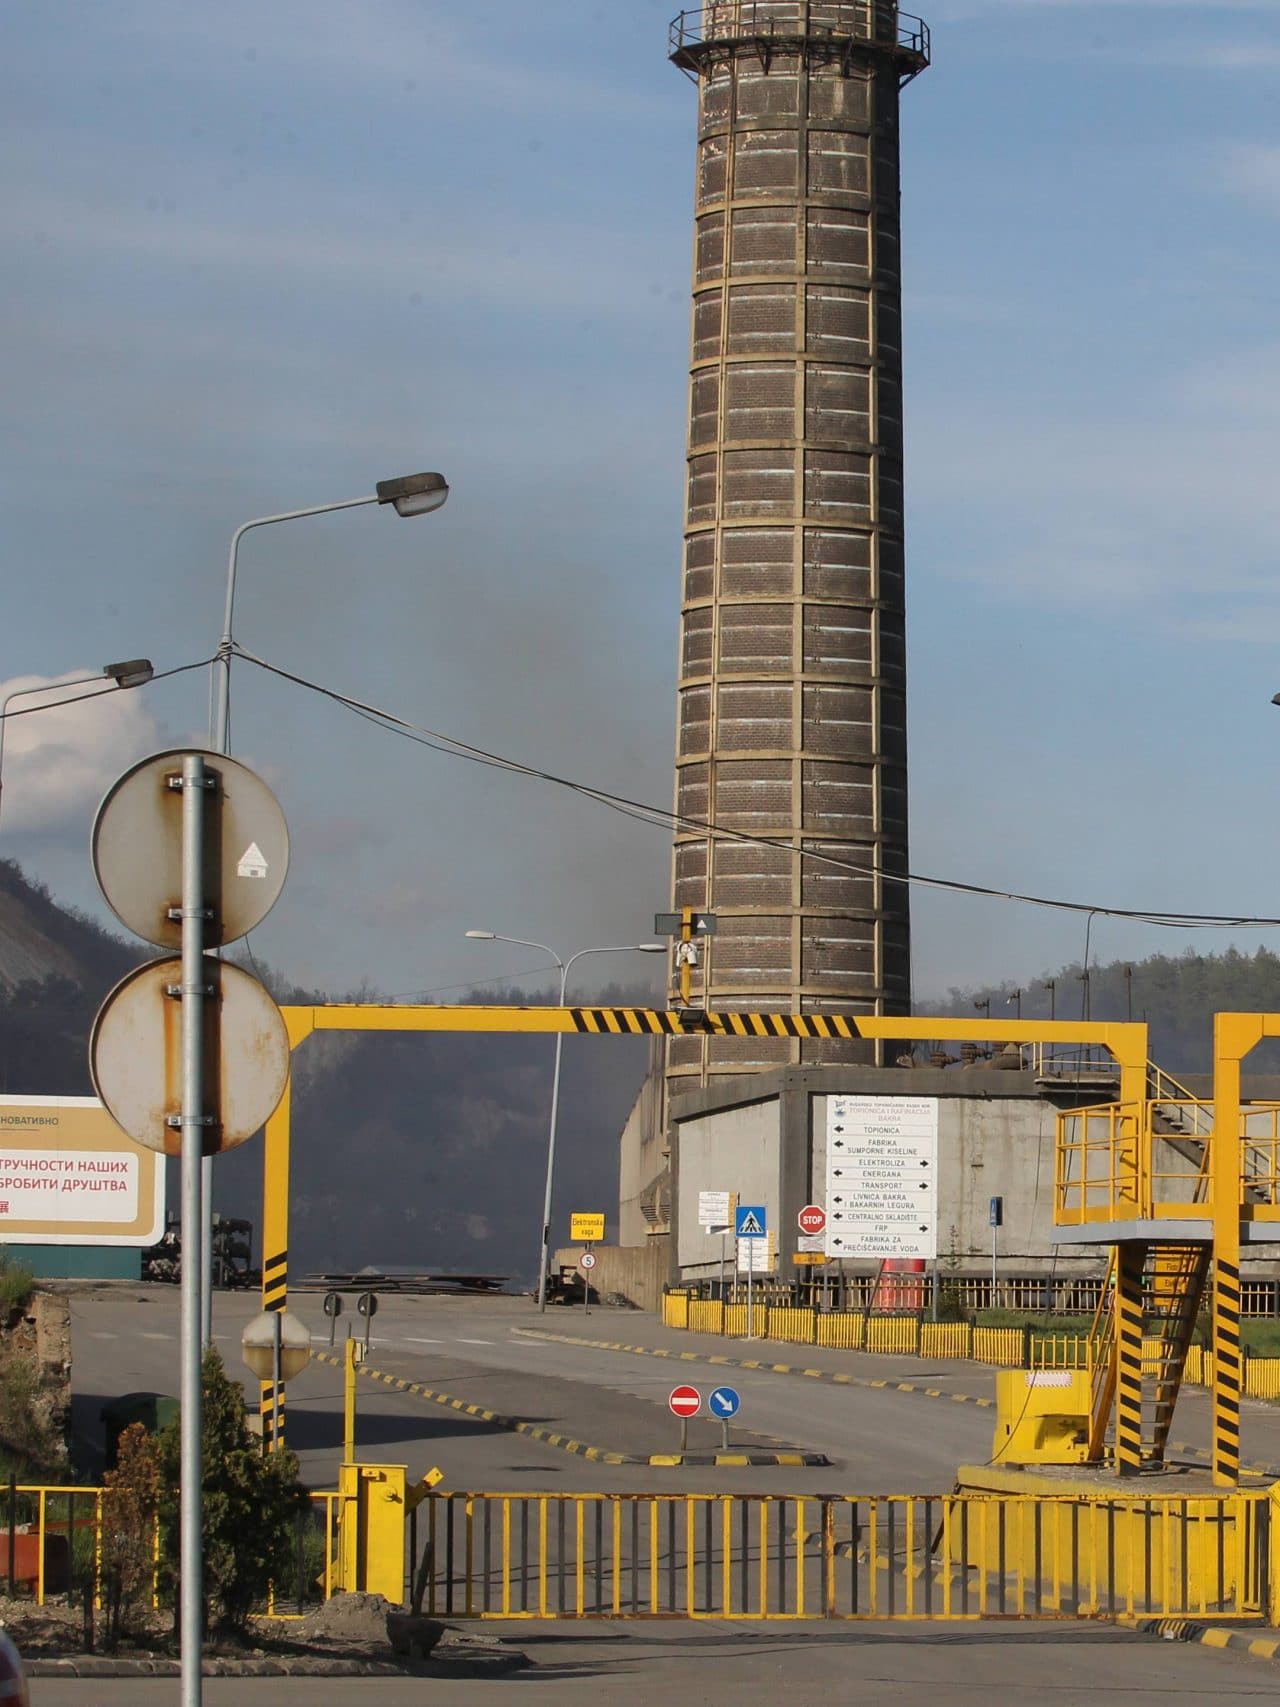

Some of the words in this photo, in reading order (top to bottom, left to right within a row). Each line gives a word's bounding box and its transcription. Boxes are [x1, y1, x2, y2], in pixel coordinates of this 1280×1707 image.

[78, 1162, 128, 1173] НАШИХ
[62, 1179, 127, 1192] ДРУШТВА
[803, 1216, 822, 1224] STOP
